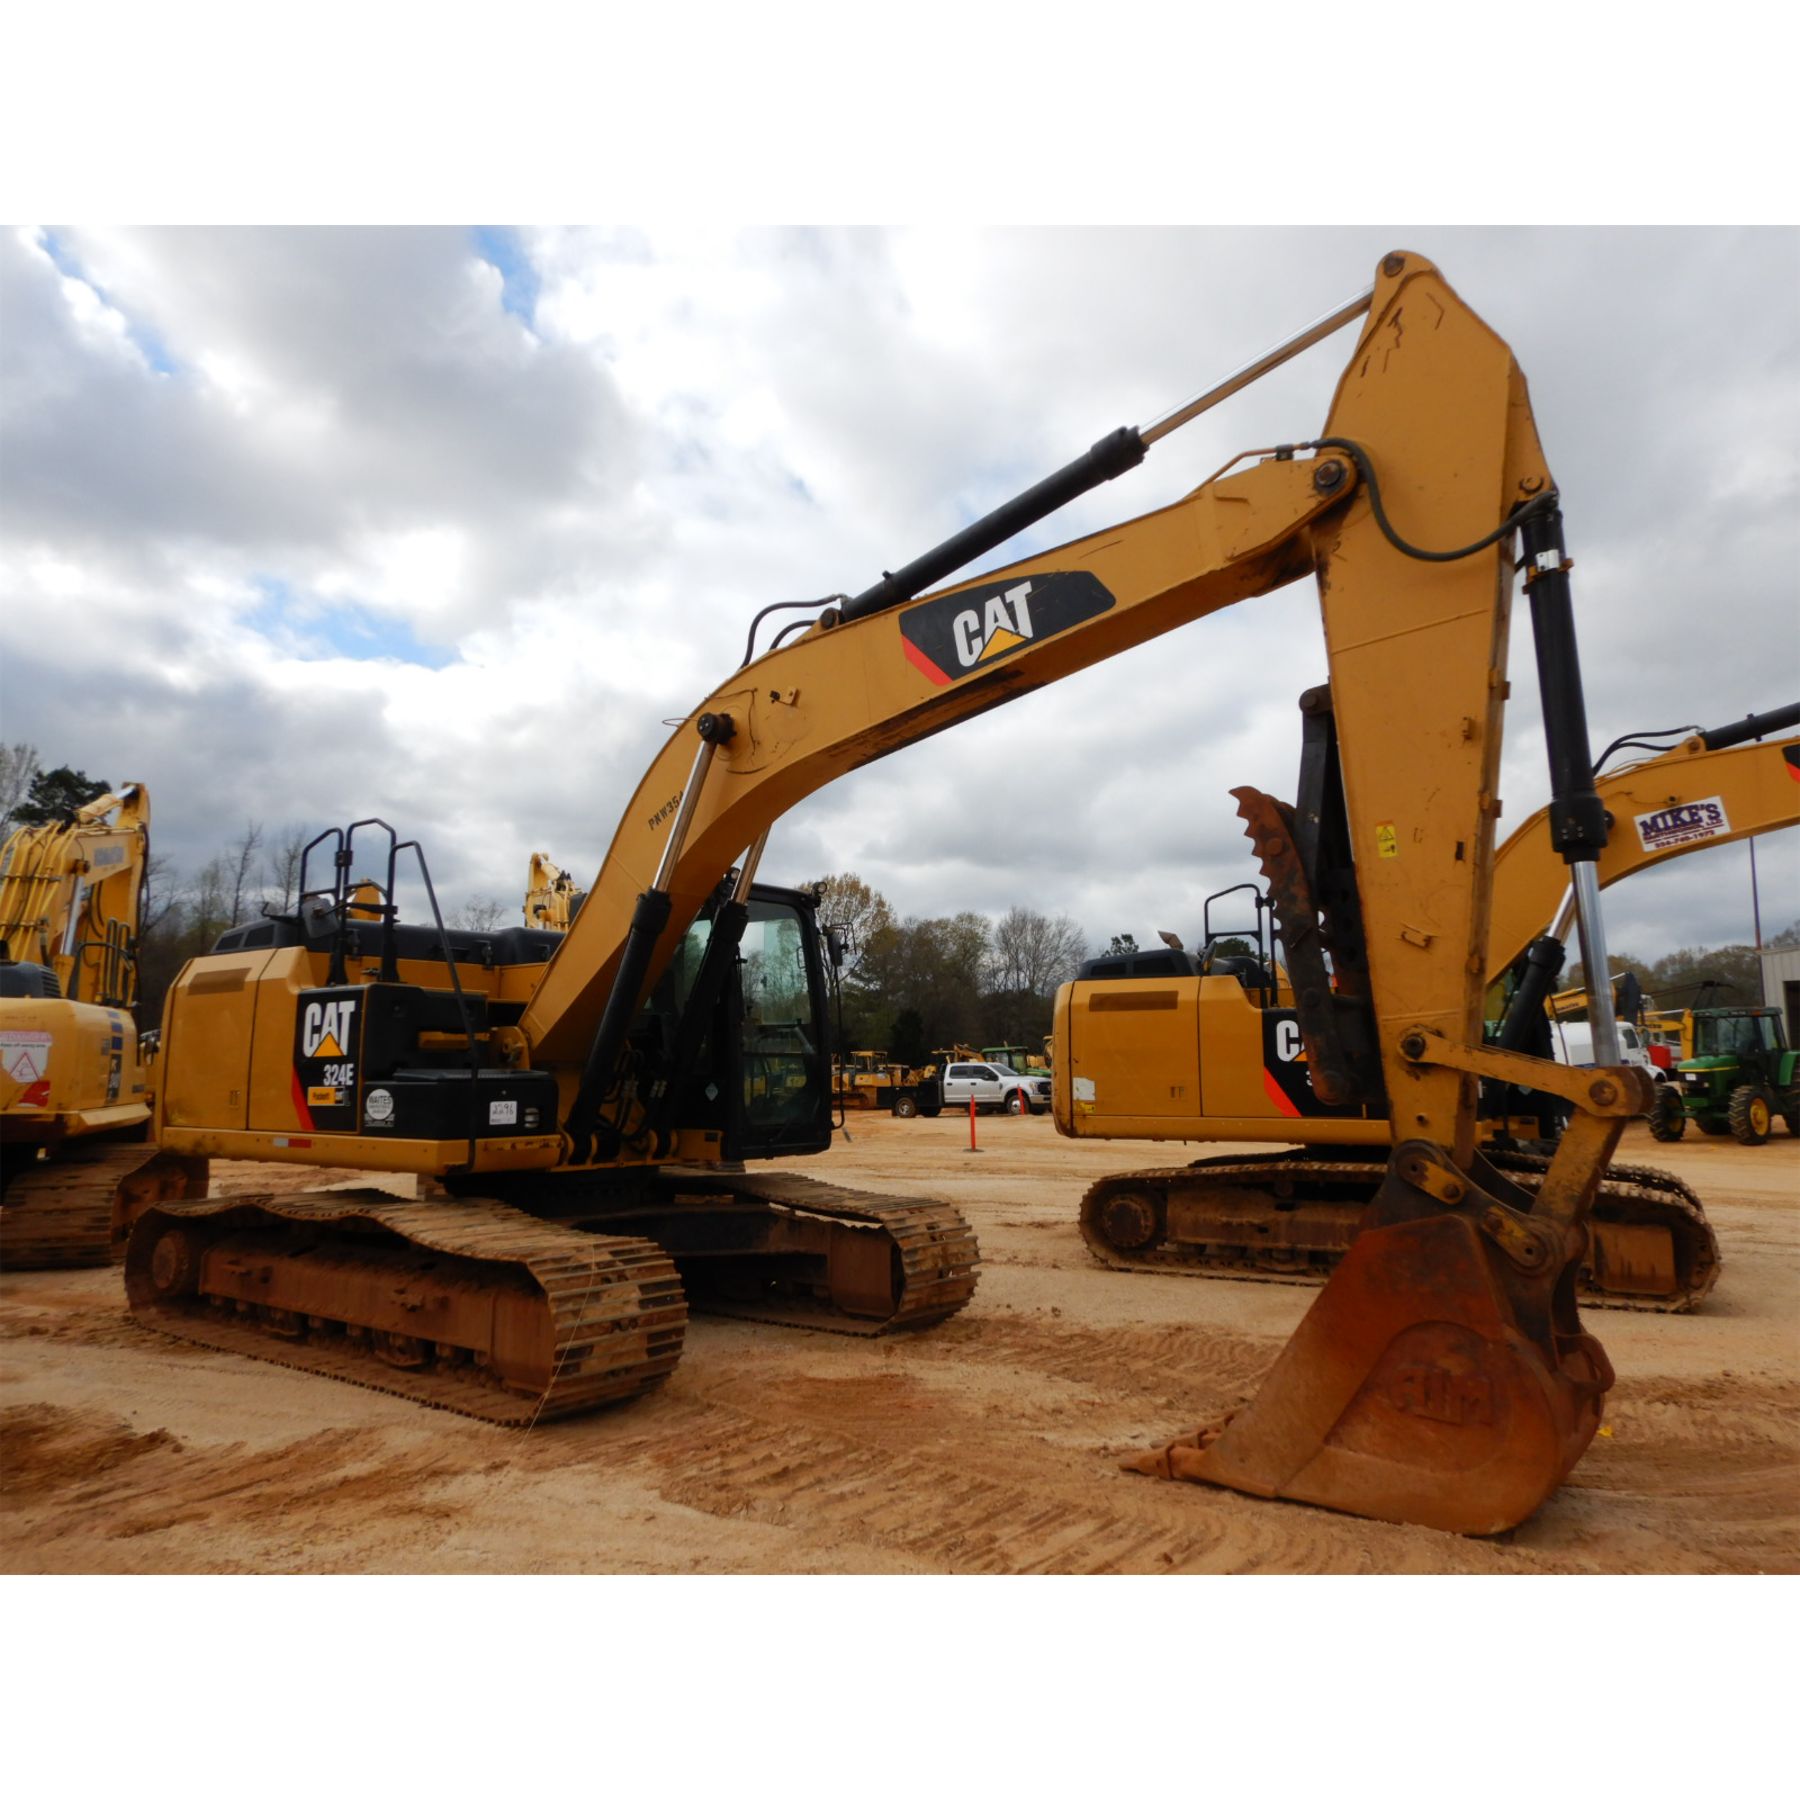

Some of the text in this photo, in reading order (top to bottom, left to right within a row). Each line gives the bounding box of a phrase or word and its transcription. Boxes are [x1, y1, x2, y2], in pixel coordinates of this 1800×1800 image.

[953, 580, 1033, 667] CAT
[1639, 803, 1721, 835] MIKE'S
[303, 1000, 355, 1058] CAT
[323, 1063, 354, 1087] 324E
